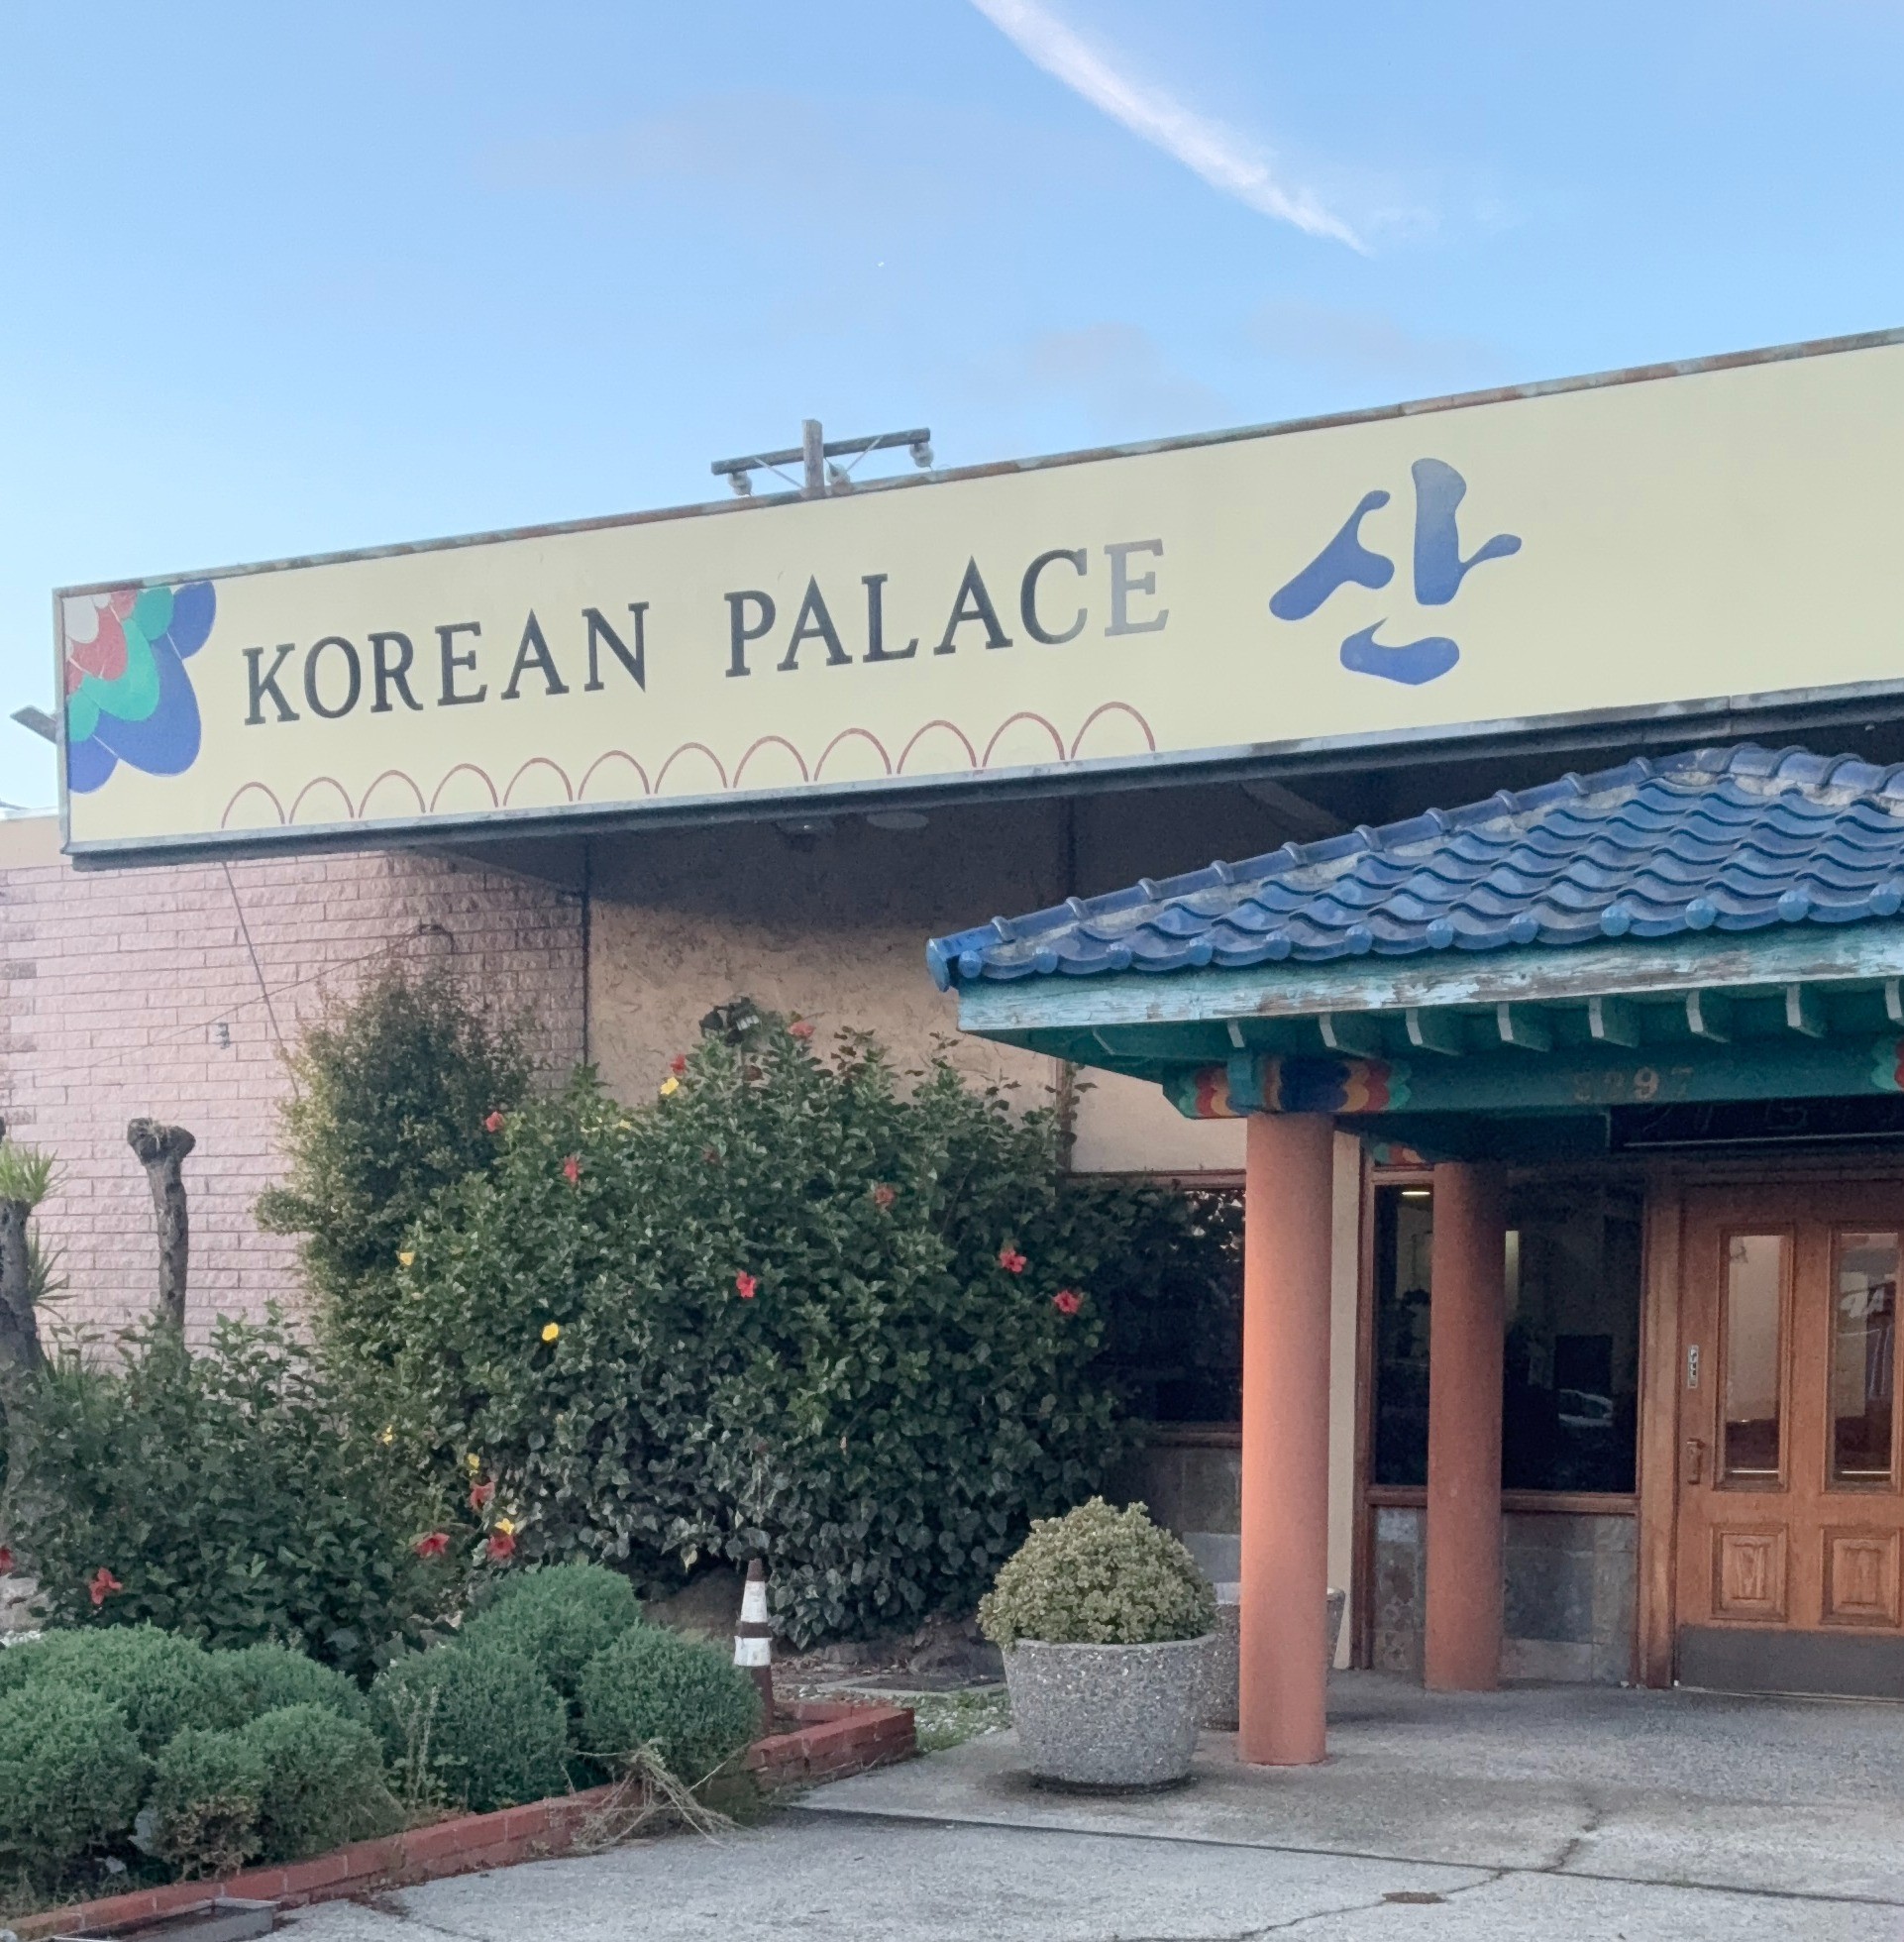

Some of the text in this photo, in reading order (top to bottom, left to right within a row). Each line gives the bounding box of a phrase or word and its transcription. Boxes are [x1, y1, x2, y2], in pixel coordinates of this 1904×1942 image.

[242, 539, 1170, 726] KOREAN PALACE
[1269, 458, 1522, 688] 산
